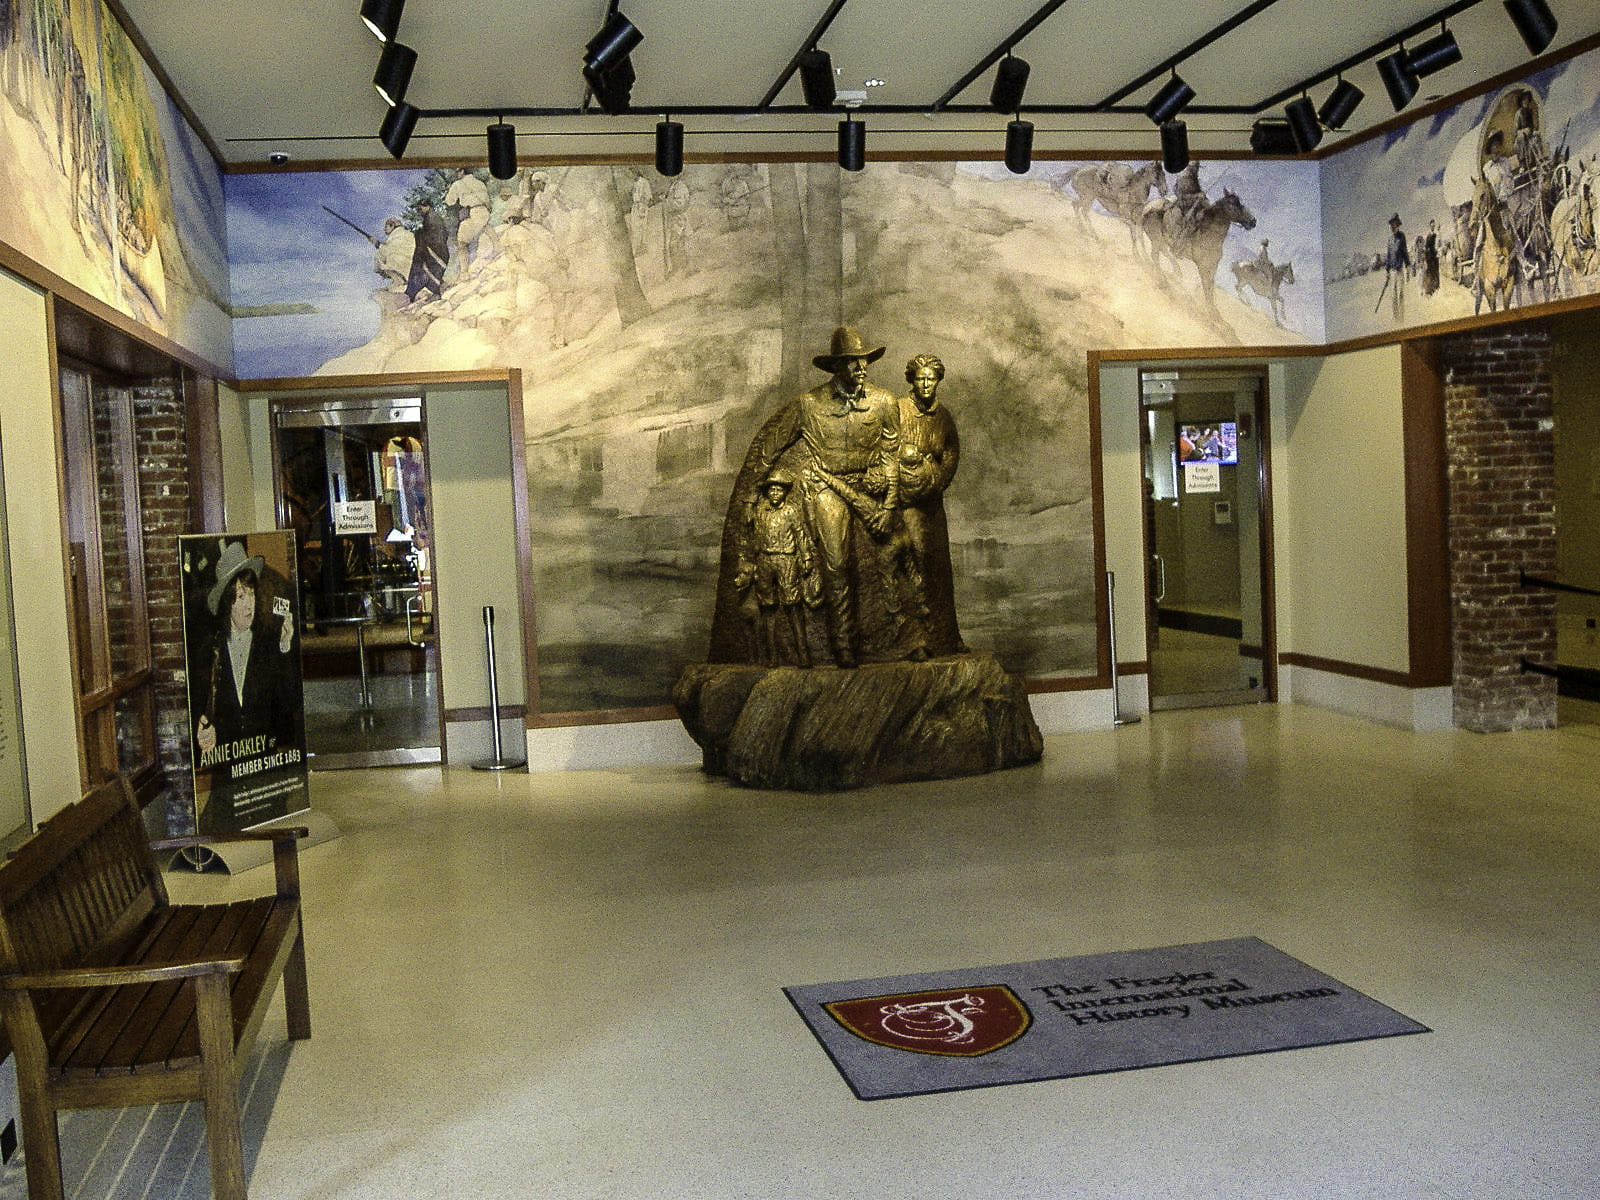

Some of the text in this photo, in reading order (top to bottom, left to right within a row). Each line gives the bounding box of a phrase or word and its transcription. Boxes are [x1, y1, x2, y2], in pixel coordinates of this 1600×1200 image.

[200, 743, 231, 768] ANNIE
[232, 734, 267, 760] OAKLEY
[231, 758, 263, 779] MEMBER
[263, 752, 284, 770] SINCE
[1031, 971, 1217, 998] The Frazier
[1046, 978, 1253, 1012] International
[1066, 987, 1341, 1026] History Museum
